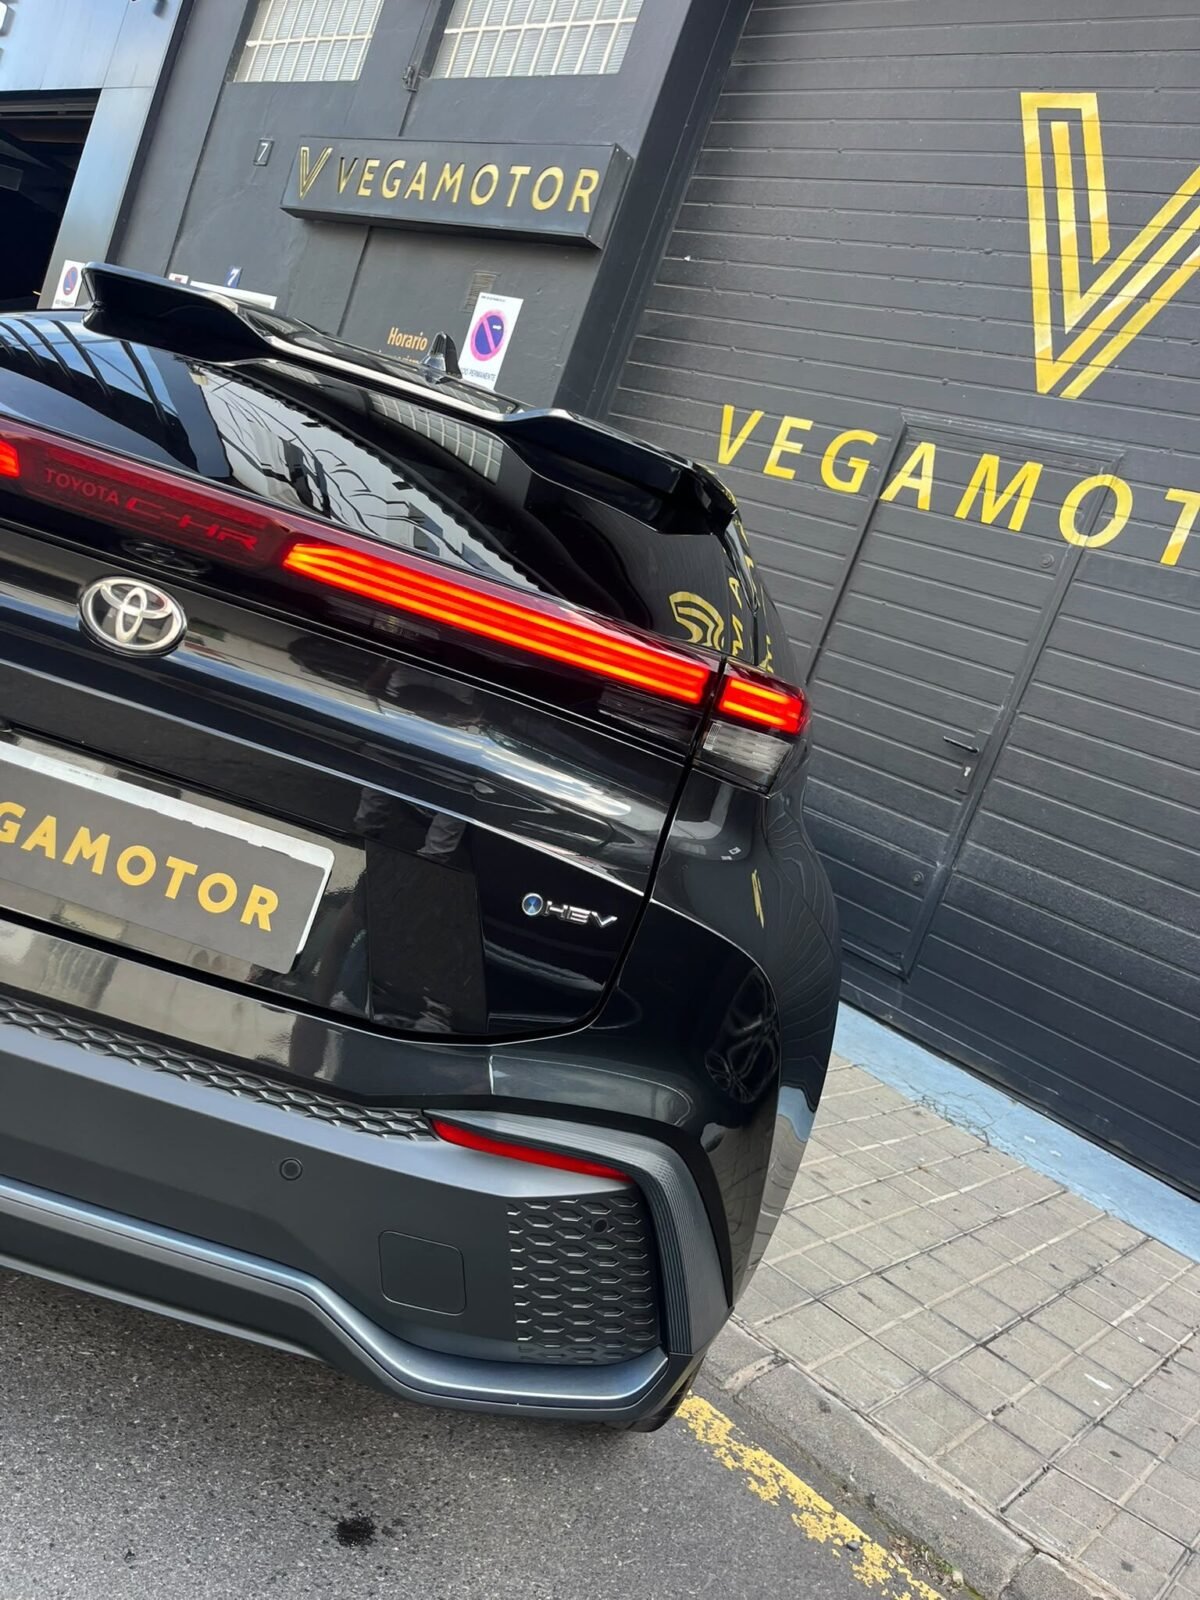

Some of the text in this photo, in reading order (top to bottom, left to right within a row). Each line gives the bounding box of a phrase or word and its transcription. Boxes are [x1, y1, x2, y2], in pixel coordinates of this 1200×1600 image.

[257, 142, 270, 162] 7
[338, 156, 599, 213] VEGAMOTOR
[387, 326, 428, 351] Horario
[45, 468, 257, 551] TOYOTA C-HR
[718, 404, 1200, 566] VEGAMOT
[0, 801, 279, 931] GAMOTOR
[545, 900, 618, 928] HEV
